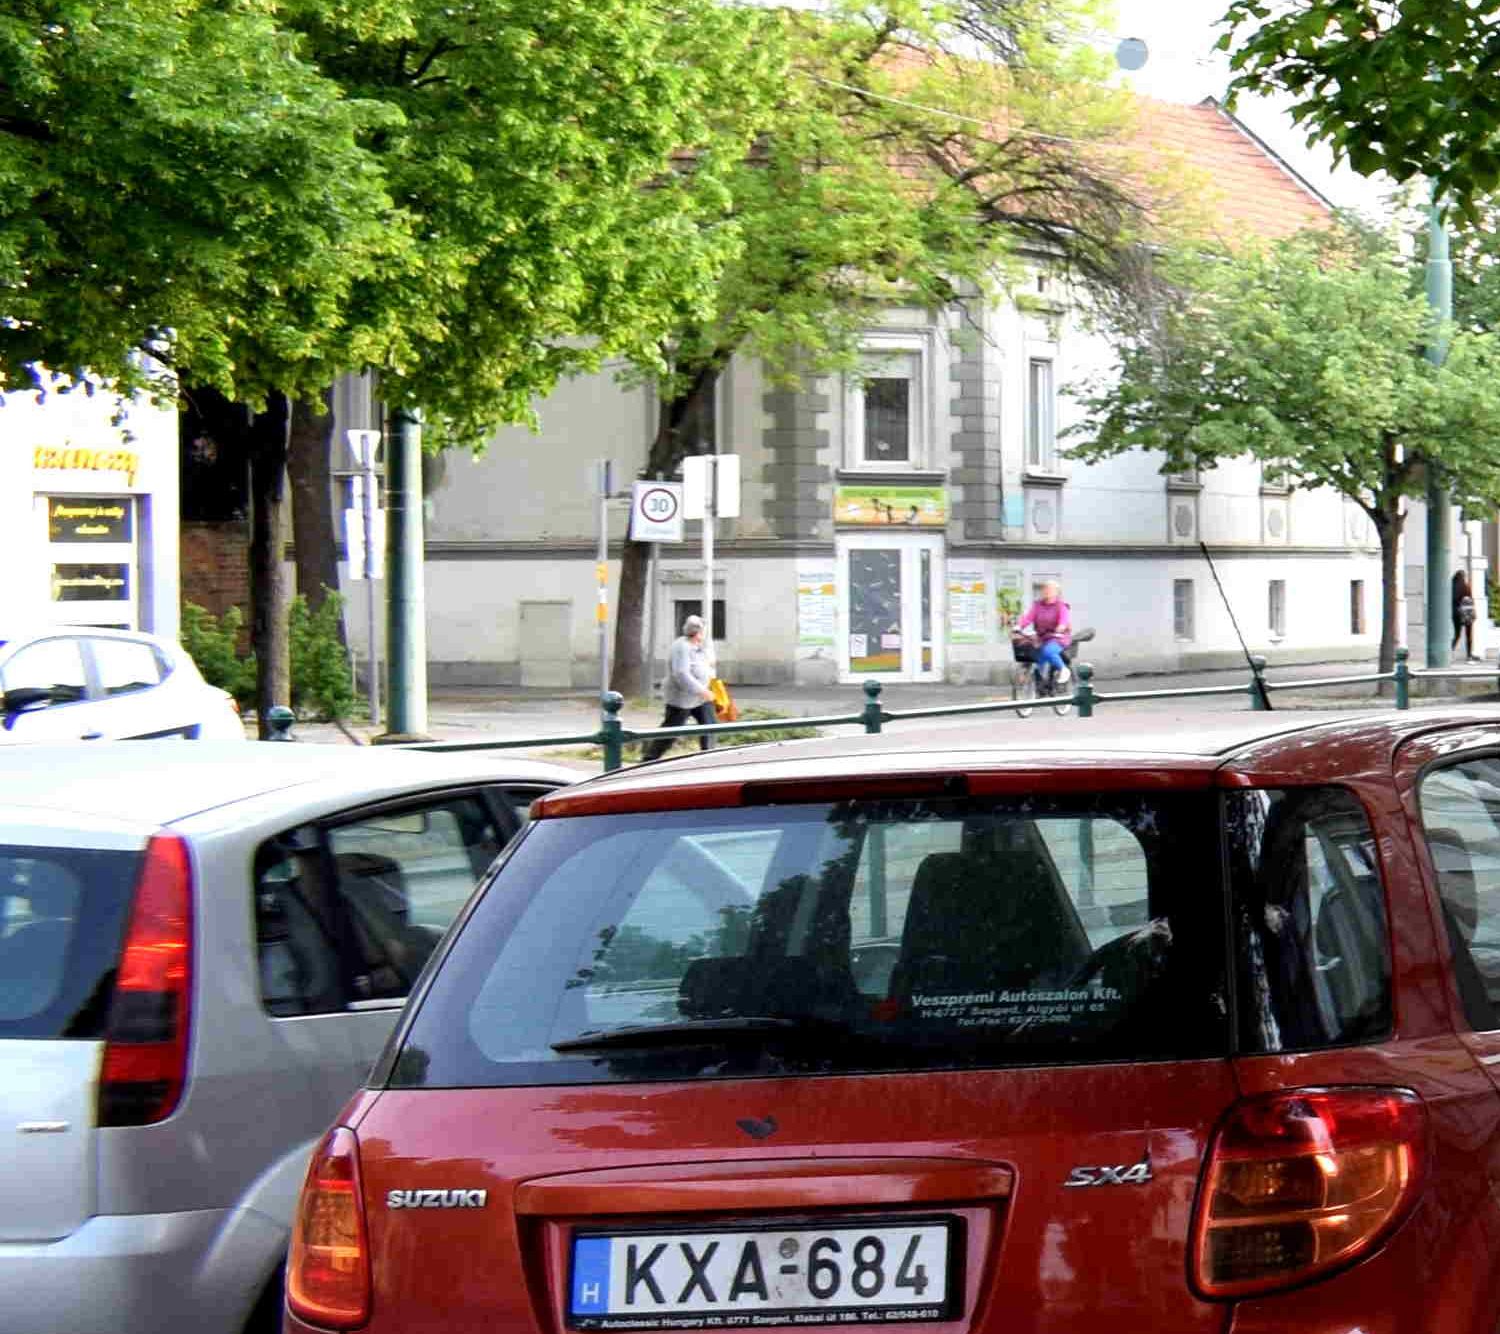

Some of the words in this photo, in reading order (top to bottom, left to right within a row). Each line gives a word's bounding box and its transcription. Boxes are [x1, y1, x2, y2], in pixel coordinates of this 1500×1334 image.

[647, 498, 669, 513] 30
[1063, 1163, 1152, 1186] SX4
[387, 1189, 487, 1208] SUZUKI
[624, 1234, 930, 1305] KXA-684
[581, 1282, 600, 1306] H
[662, 1317, 704, 1328] Hungary
